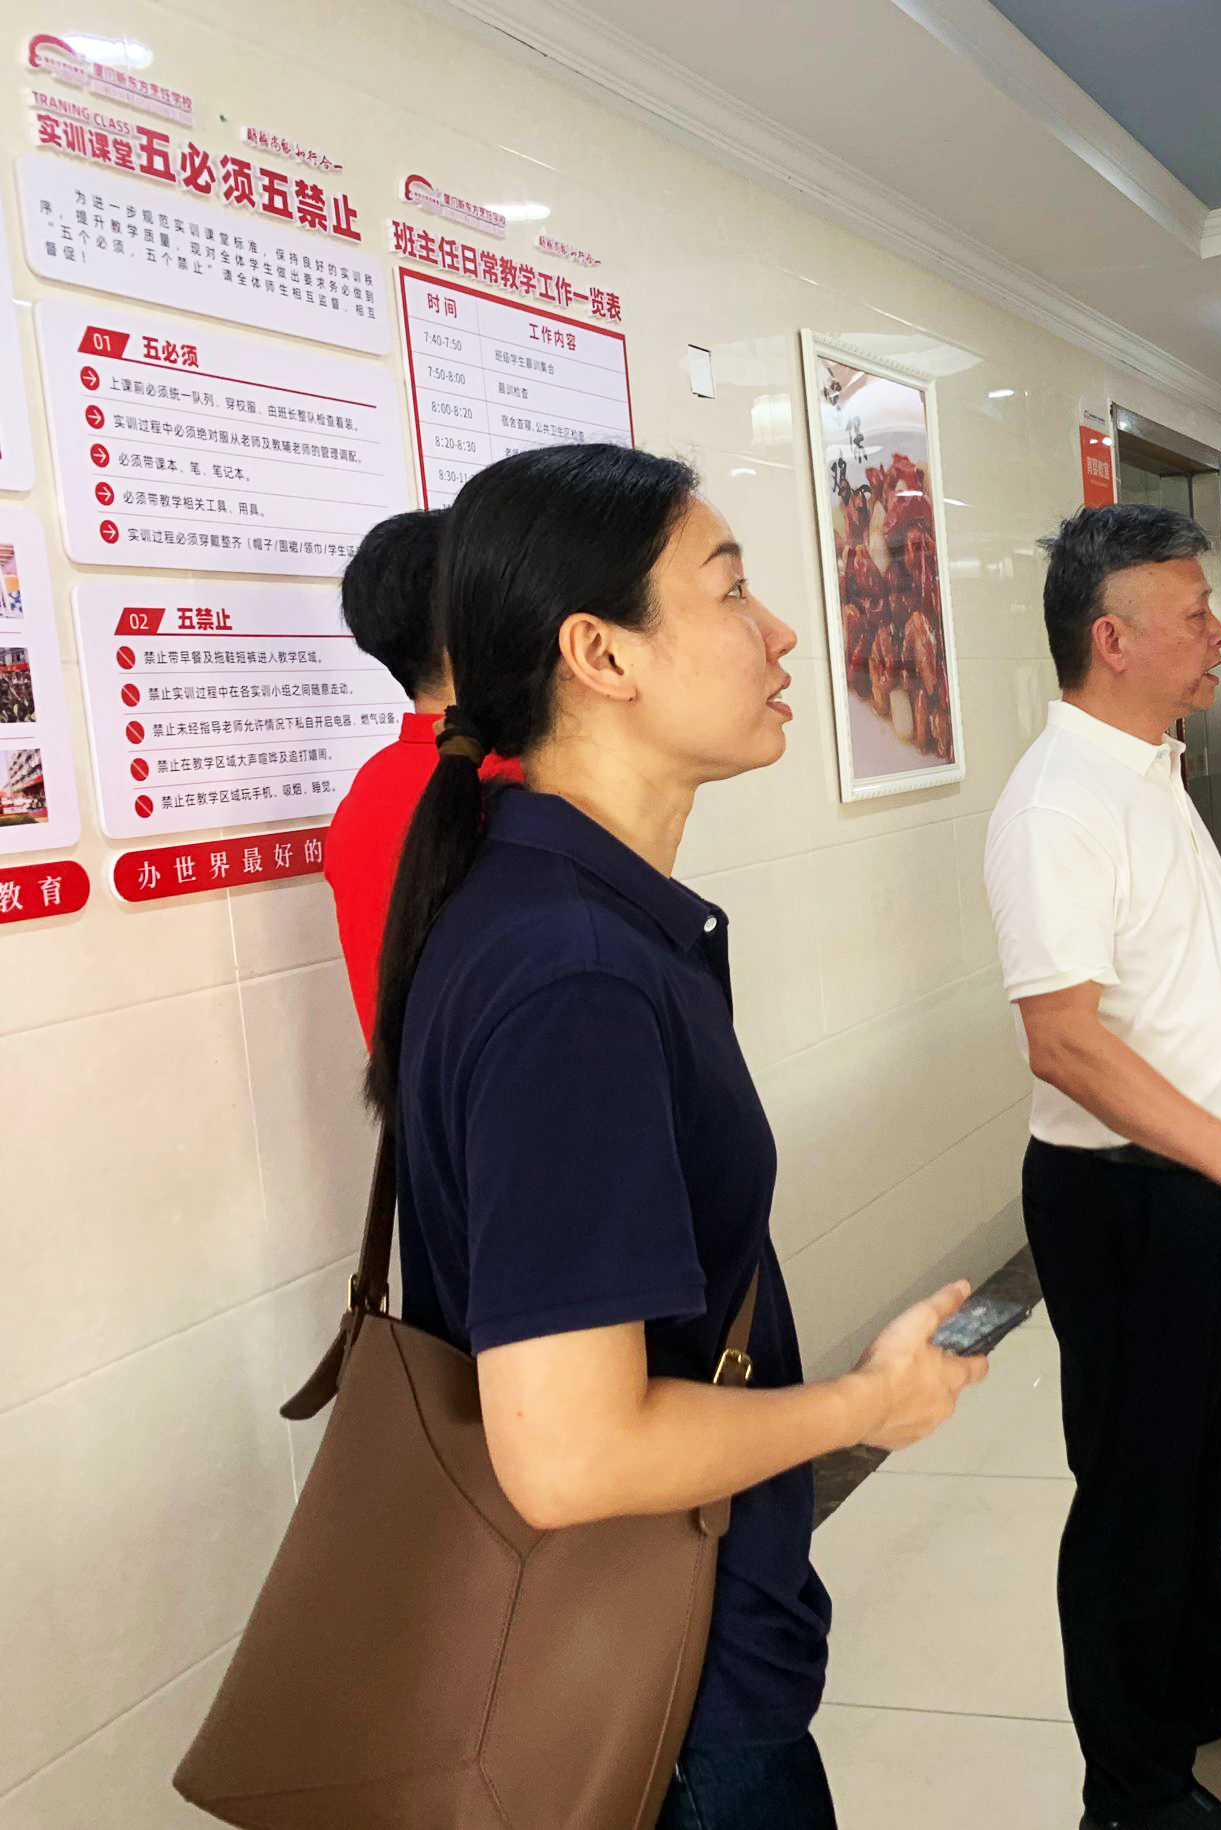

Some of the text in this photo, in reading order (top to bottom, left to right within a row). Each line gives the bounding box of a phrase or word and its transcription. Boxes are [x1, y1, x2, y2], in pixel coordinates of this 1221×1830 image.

[32, 90, 90, 121] TRANING
[93, 112, 130, 134] CLASS
[36, 113, 361, 242] 实训课堂 五必须五禁止
[392, 219, 622, 322] 班主任日常教学工作一览表
[427, 293, 457, 319] 时间
[93, 333, 111, 352] 01
[424, 331, 462, 352] 7:40-7:50
[528, 323, 577, 352] 工作内容
[142, 336, 199, 368] 五必须
[427, 365, 466, 386] 7:50-8:00
[431, 400, 473, 420] 8:00-8:20
[434, 435, 476, 454] 8:20-8:30
[129, 613, 149, 630] 02
[177, 607, 233, 631] 五禁止
[138, 842, 322, 891] 办世界最好的
